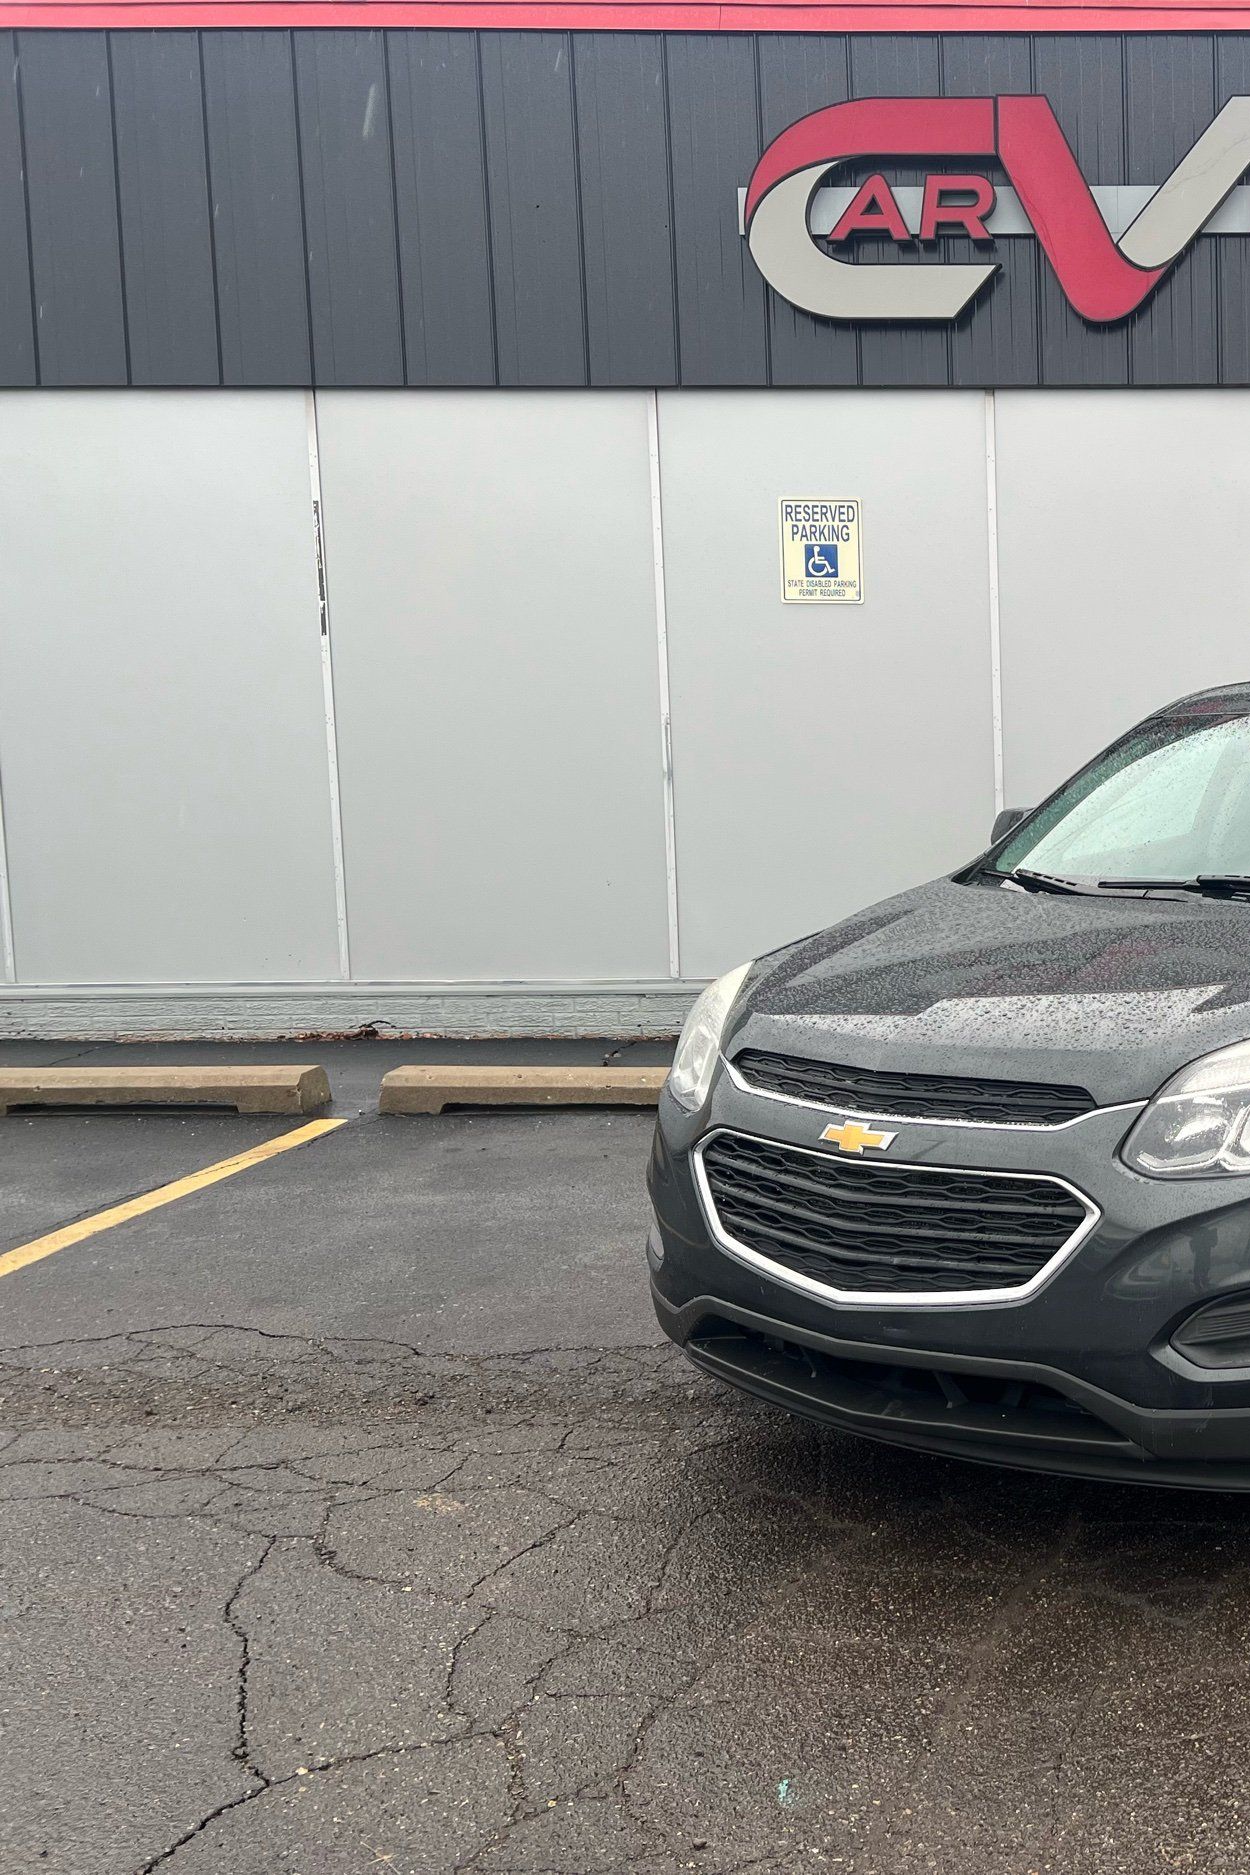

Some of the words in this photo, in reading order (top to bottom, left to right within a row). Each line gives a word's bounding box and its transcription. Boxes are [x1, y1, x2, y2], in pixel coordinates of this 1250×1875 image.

[785, 504, 855, 522] RESERVED
[791, 524, 850, 542] PARKING
[788, 579, 804, 587] STATE
[806, 580, 831, 588] DISABLED
[834, 580, 856, 588] PARKING
[820, 589, 846, 597] REQUIRED
